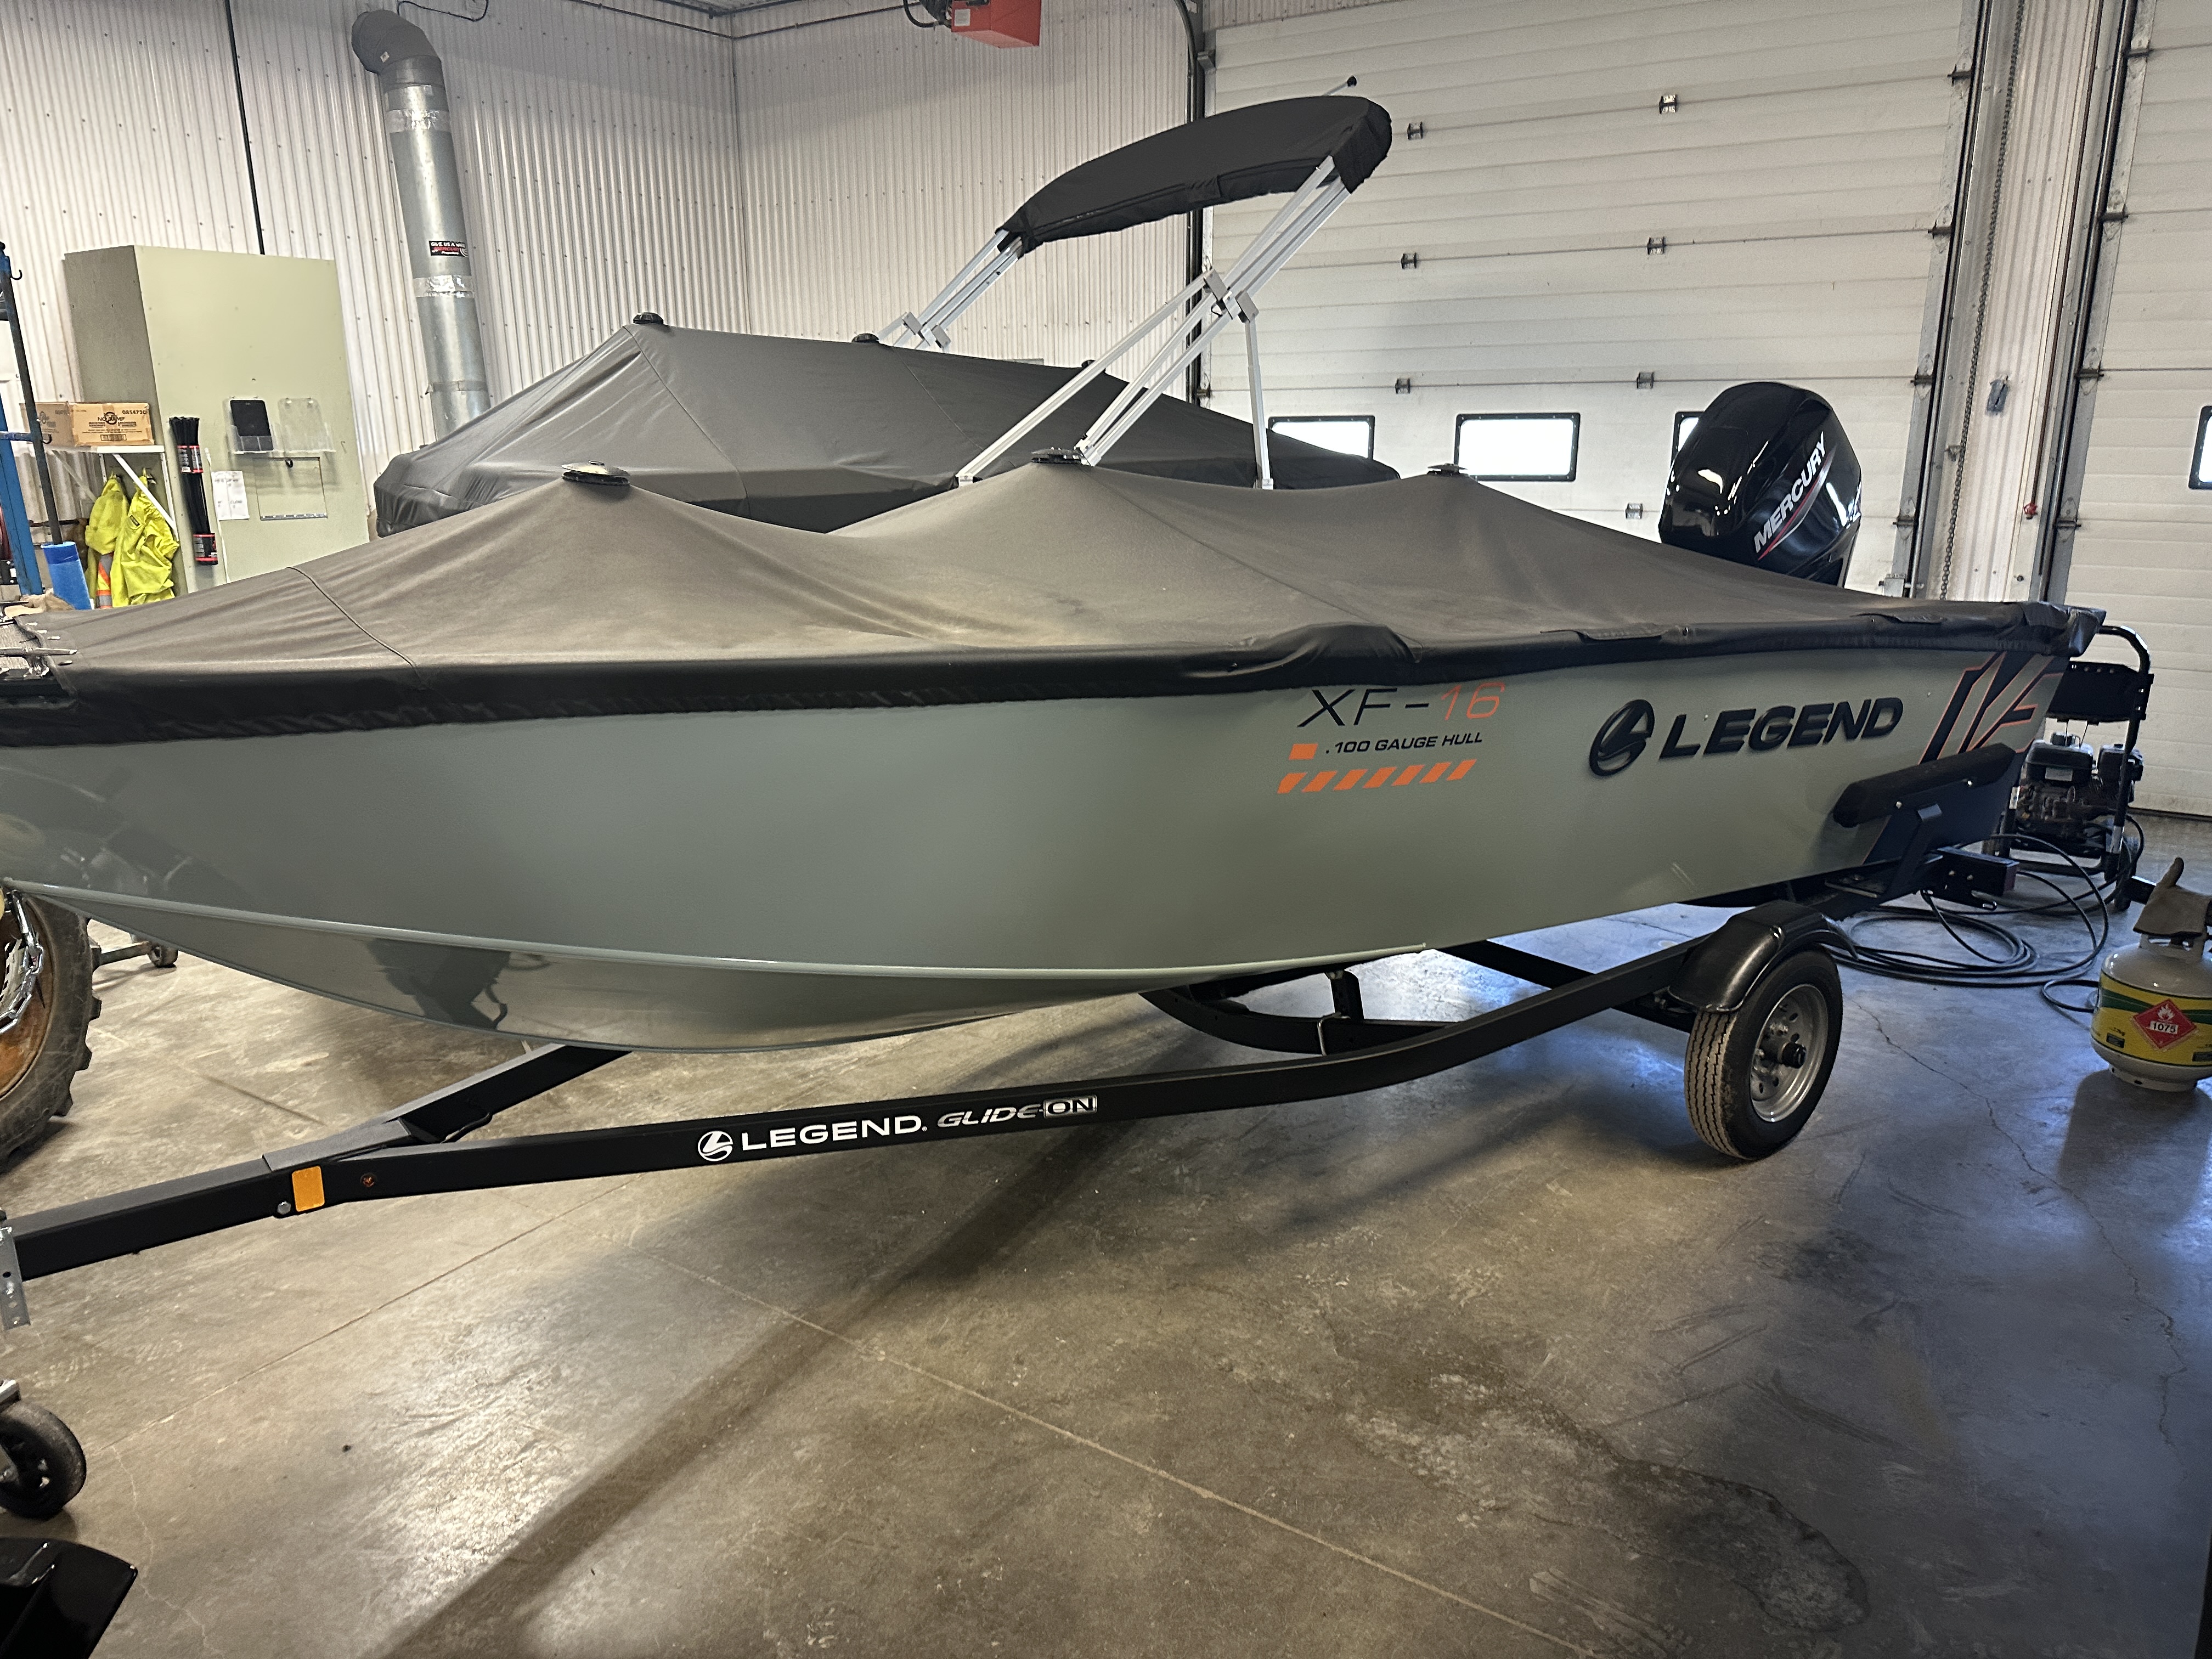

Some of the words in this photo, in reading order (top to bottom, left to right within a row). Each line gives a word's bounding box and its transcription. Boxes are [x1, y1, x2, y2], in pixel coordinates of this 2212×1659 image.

[1754, 431, 1825, 554] MERCURY
[1374, 736, 1438, 752] GAUGE
[1441, 732, 1483, 747] HULL
[1658, 697, 1904, 760] LEGEND
[2153, 1023, 2176, 1033] 1075
